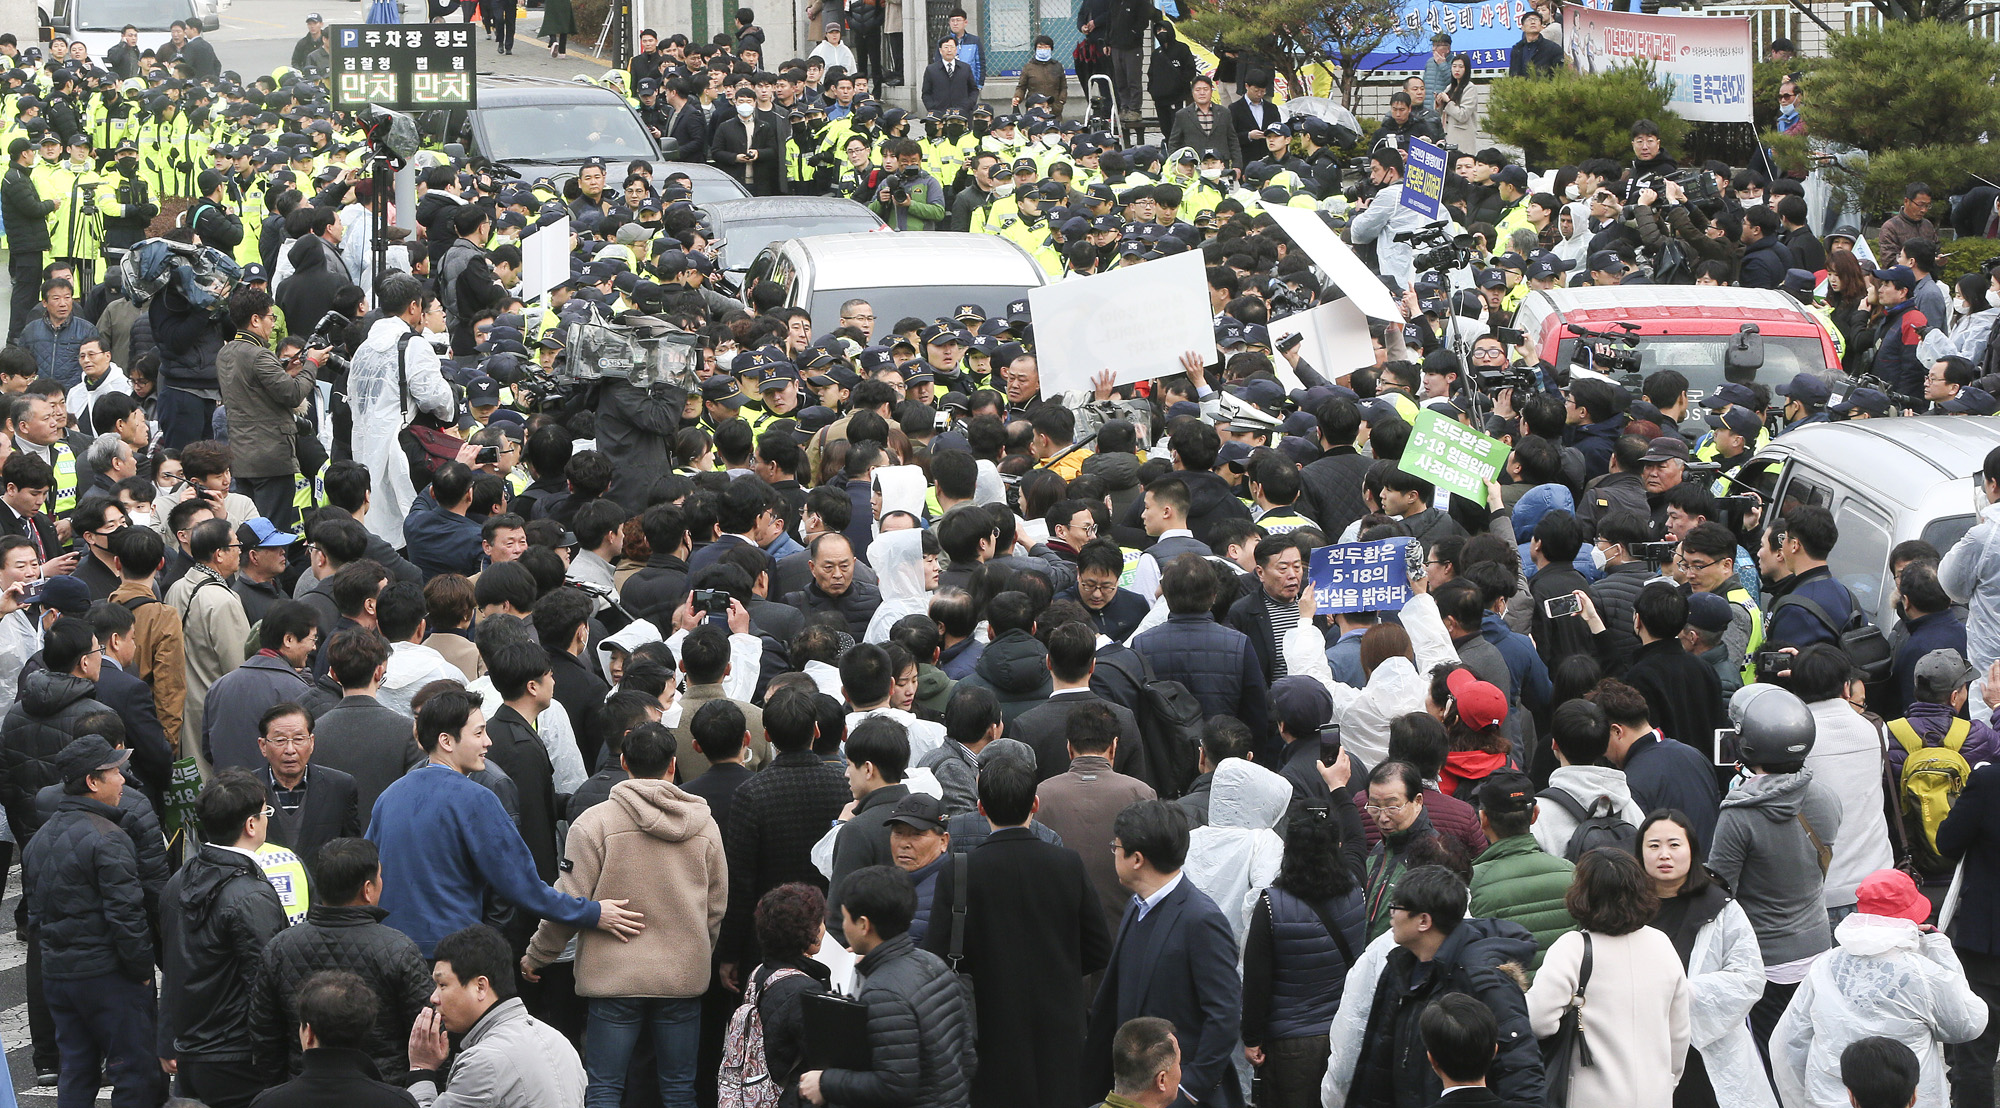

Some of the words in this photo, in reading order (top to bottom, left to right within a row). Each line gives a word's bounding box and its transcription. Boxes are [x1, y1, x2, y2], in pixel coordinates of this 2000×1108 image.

[344, 31, 356, 46] P
[365, 30, 422, 48] 주차장
[434, 30, 468, 48] 정보
[1603, 27, 1637, 58] 10년만의
[343, 57, 391, 70] 검찰청
[1472, 49, 1506, 65] 상조회
[341, 73, 397, 102] 만차
[414, 73, 470, 102] 만차
[1433, 417, 1492, 457] 전두환은
[1415, 453, 1479, 493] 사죄하라!
[1448, 447, 1496, 480] 영령앞에
[1328, 543, 1396, 565] 전두환은
[1332, 565, 1388, 583] 5·18의
[1315, 589, 1359, 608] 진실을
[1362, 588, 1407, 607] 밝혀라
